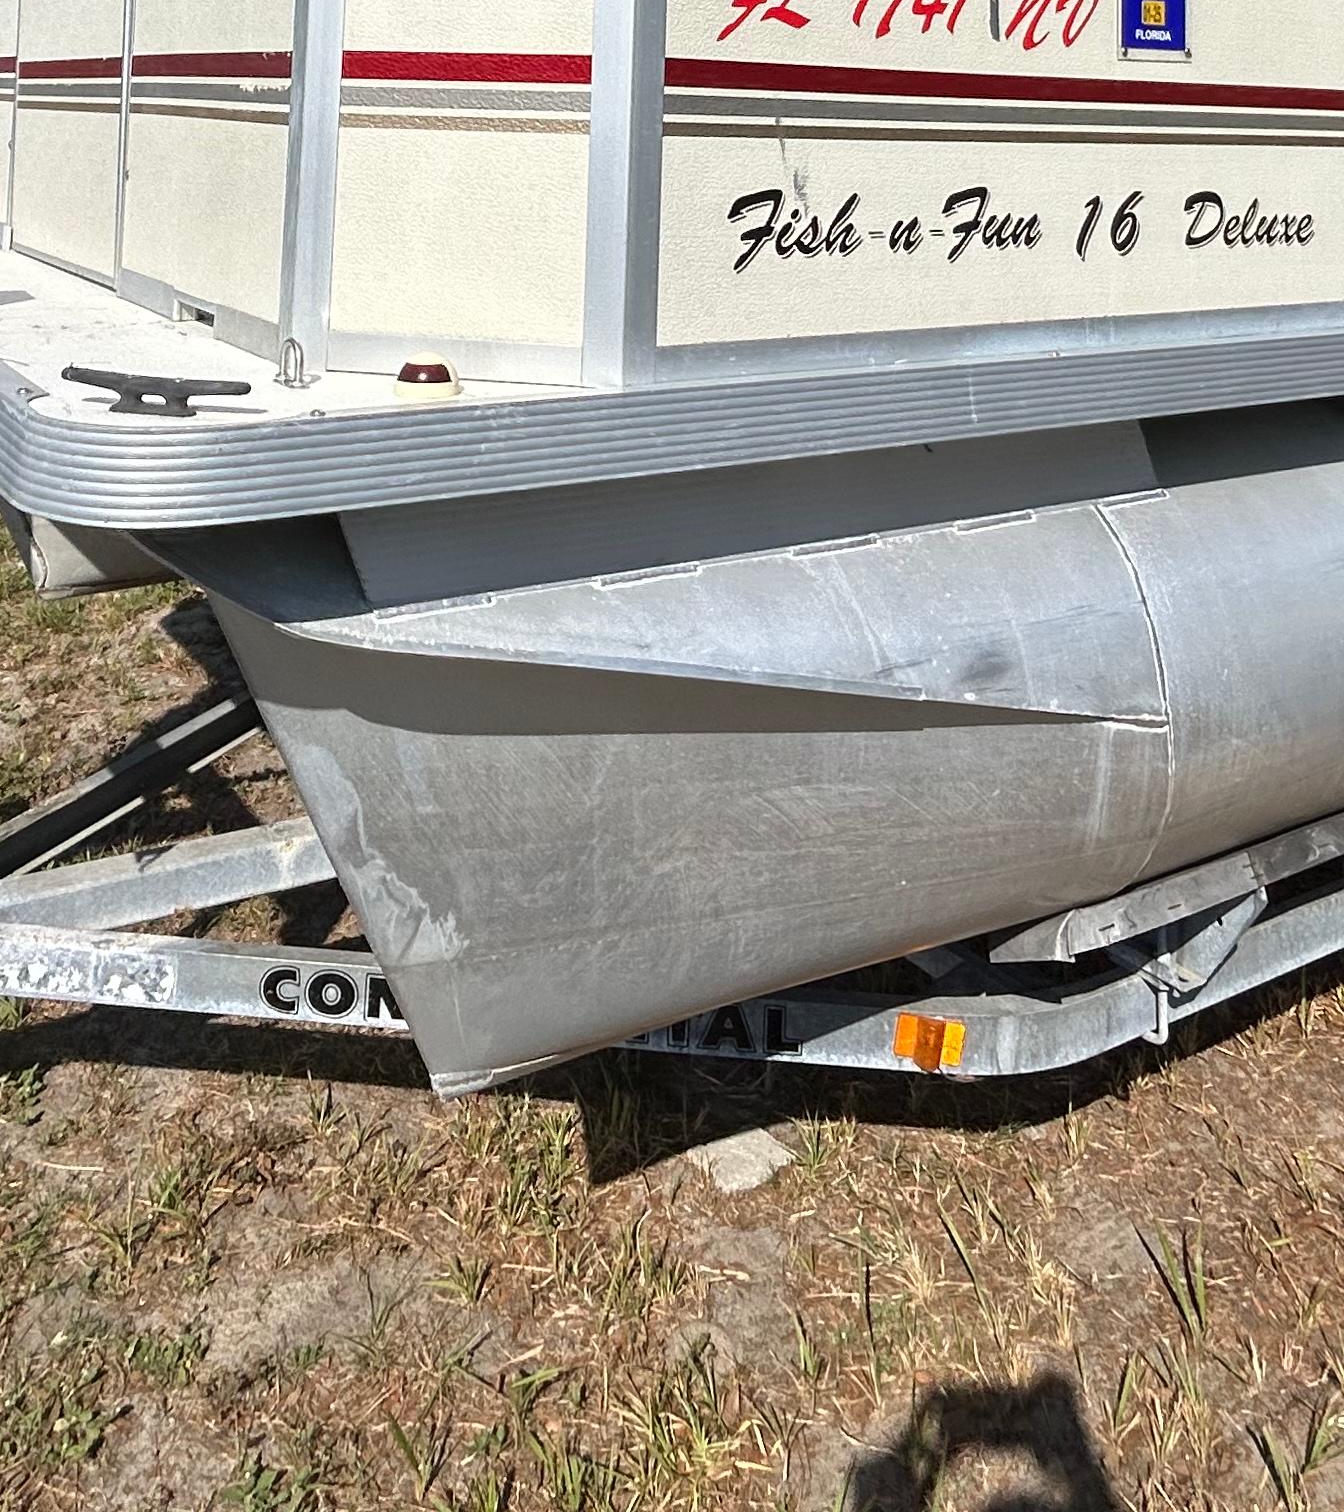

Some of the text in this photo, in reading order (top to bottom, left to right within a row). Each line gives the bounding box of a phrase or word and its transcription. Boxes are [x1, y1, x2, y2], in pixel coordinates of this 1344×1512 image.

[1135, 28, 1172, 42] FLORIDA
[727, 186, 1315, 274] Fish-n-Fun 16 Deluxe
